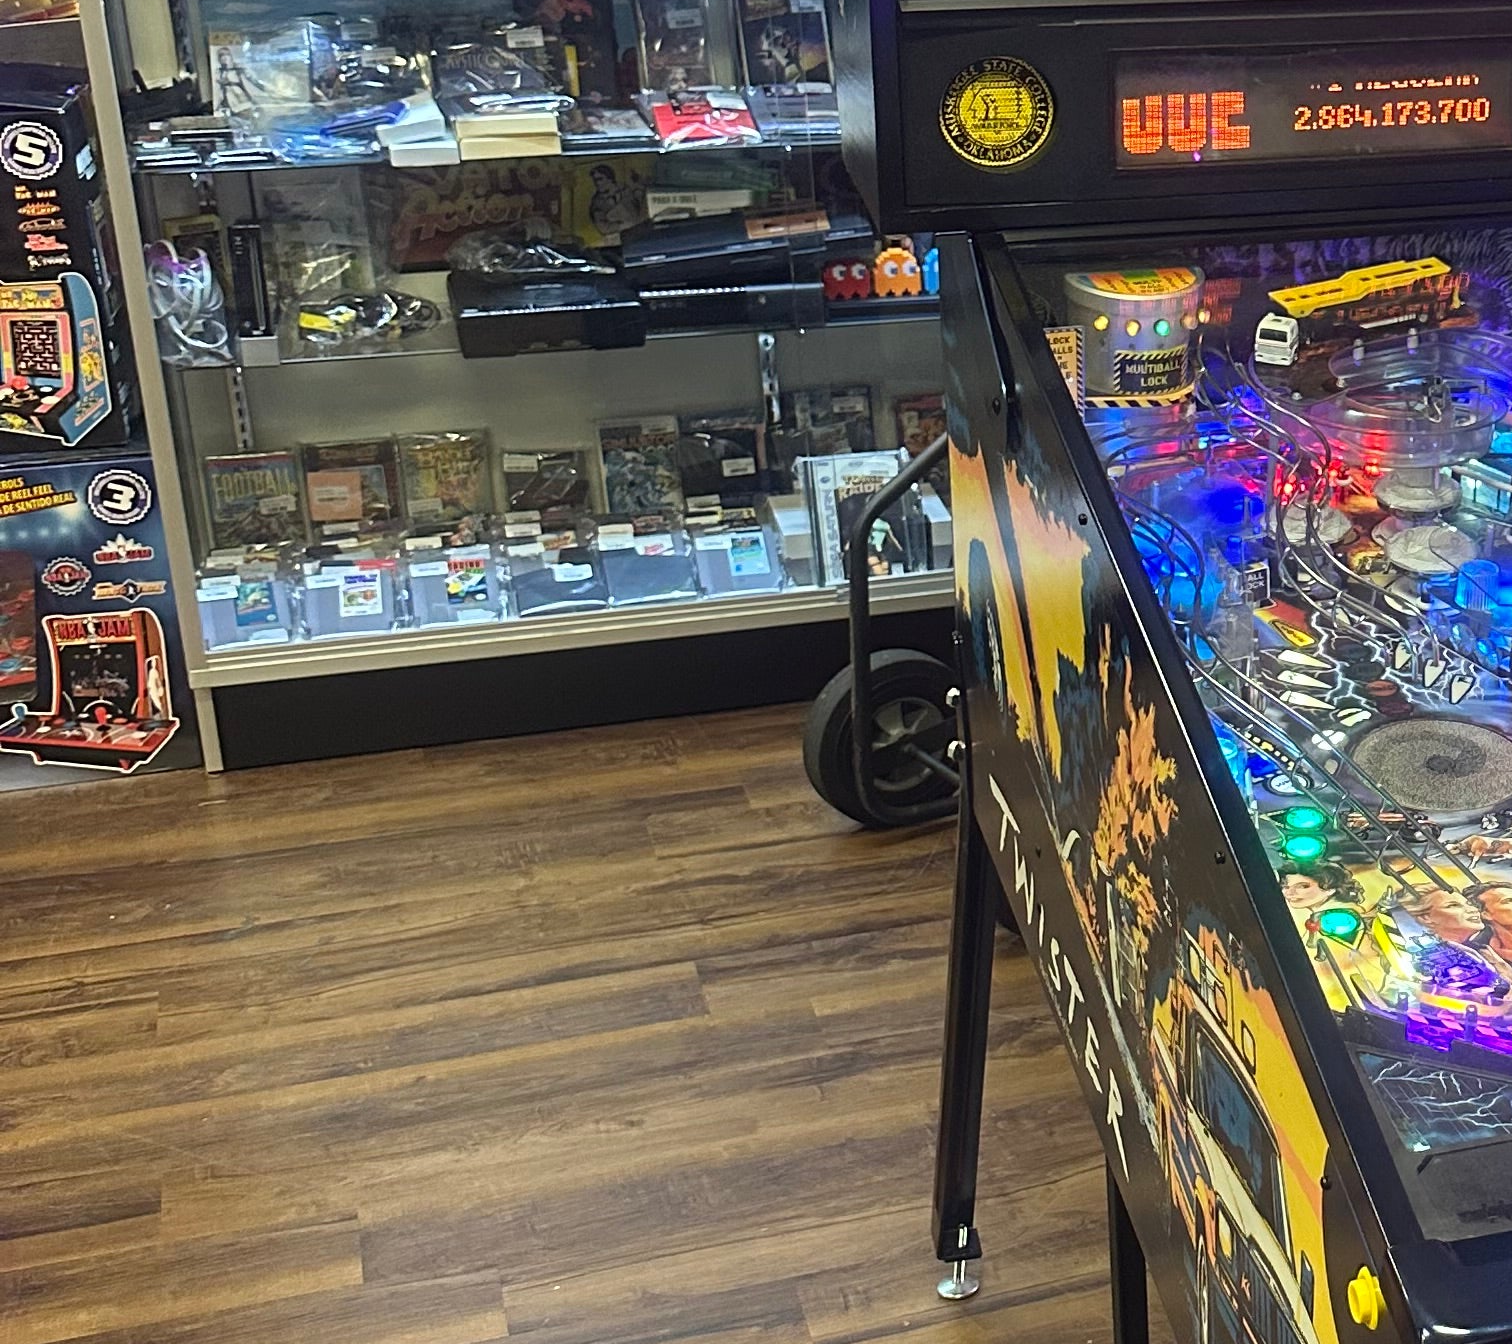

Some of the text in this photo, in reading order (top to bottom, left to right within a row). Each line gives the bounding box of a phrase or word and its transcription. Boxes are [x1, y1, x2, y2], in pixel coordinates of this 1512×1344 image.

[1124, 358, 1181, 375] MULTIBALL
[1140, 375, 1168, 388] LOCK
[103, 481, 137, 512] 3
[97, 618, 131, 639] JAM
[988, 771, 1130, 1185] TWISTER
